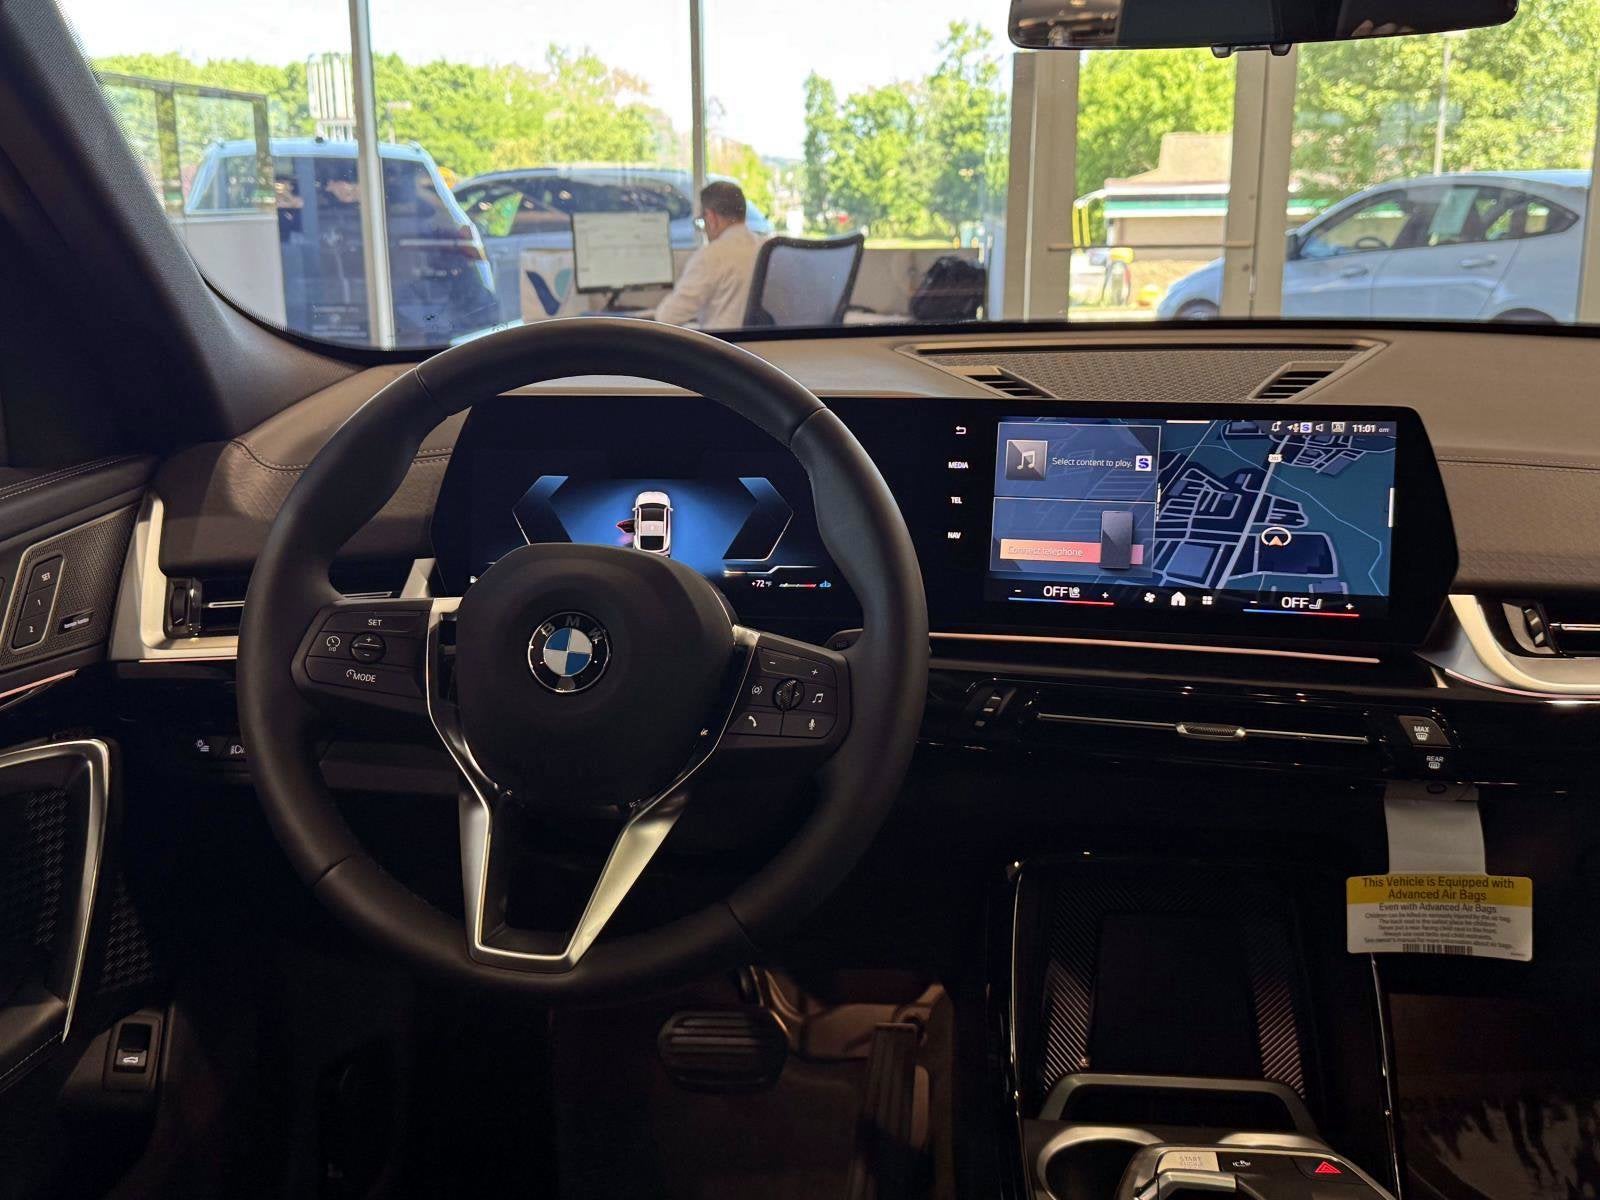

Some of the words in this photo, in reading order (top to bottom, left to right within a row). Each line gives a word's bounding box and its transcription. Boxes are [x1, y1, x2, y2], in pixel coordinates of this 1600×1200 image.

[1352, 424, 1376, 433] 11:01
[948, 461, 969, 469] MEDIA
[1052, 456, 1076, 466] Select
[1076, 458, 1104, 467] content
[1106, 459, 1113, 467] to
[1115, 459, 1133, 469] play.
[950, 496, 962, 504] TEL
[947, 531, 961, 539] NAV
[1009, 546, 1041, 555] Connect
[1042, 547, 1084, 557] telephone
[1043, 585, 1068, 597] OFF
[1281, 596, 1309, 609] OFF
[367, 618, 383, 626] SET
[352, 672, 377, 683] MODE
[1413, 725, 1430, 733] MAX
[1362, 877, 1384, 888] This
[1386, 876, 1424, 887] Vehicle
[1426, 877, 1436, 887] is
[1438, 876, 1489, 889] Equipped
[1491, 878, 1514, 889] with
[1388, 888, 1439, 900] Advanced
[1442, 889, 1457, 900] Air
[1459, 889, 1487, 903] Bags
[1379, 902, 1399, 911] Even
[1400, 903, 1418, 911] with
[1419, 902, 1460, 912] Advanced
[1462, 903, 1473, 912] Air
[1475, 904, 1497, 914] Bags
